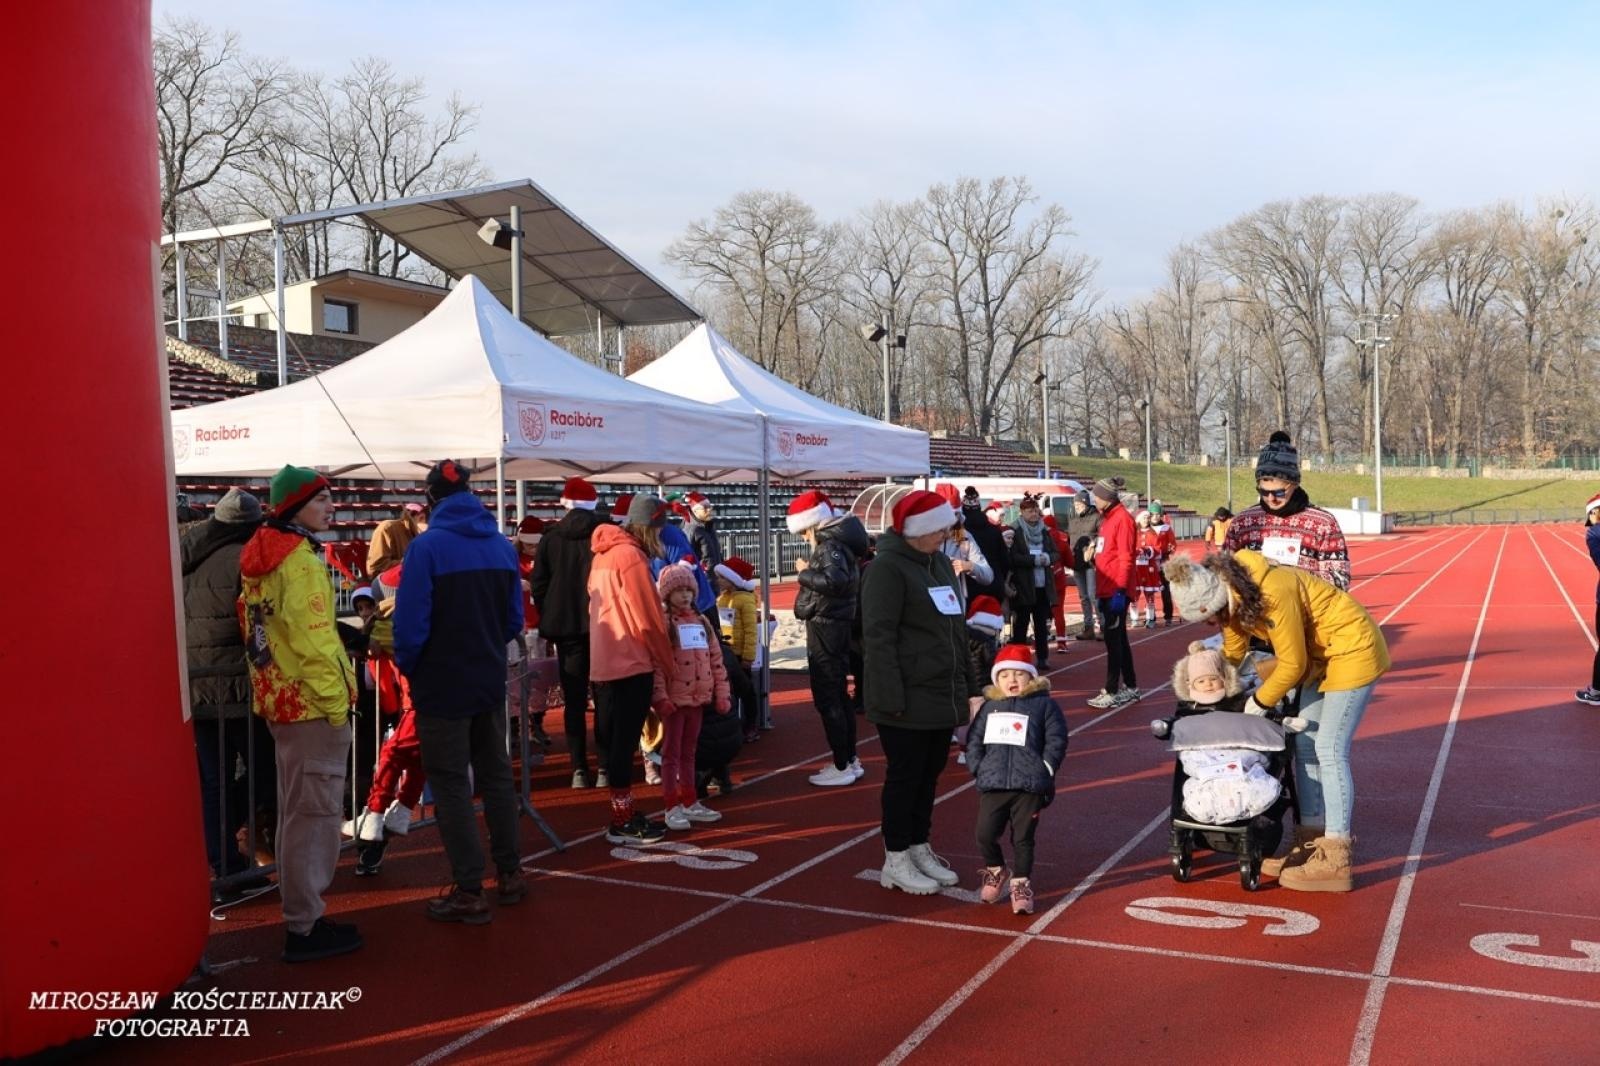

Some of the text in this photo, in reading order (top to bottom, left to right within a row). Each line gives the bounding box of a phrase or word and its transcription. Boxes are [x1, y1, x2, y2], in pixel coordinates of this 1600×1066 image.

[550, 410, 604, 428] Racibórz
[195, 425, 250, 442] Racibórz
[796, 432, 829, 447] Racibórz
